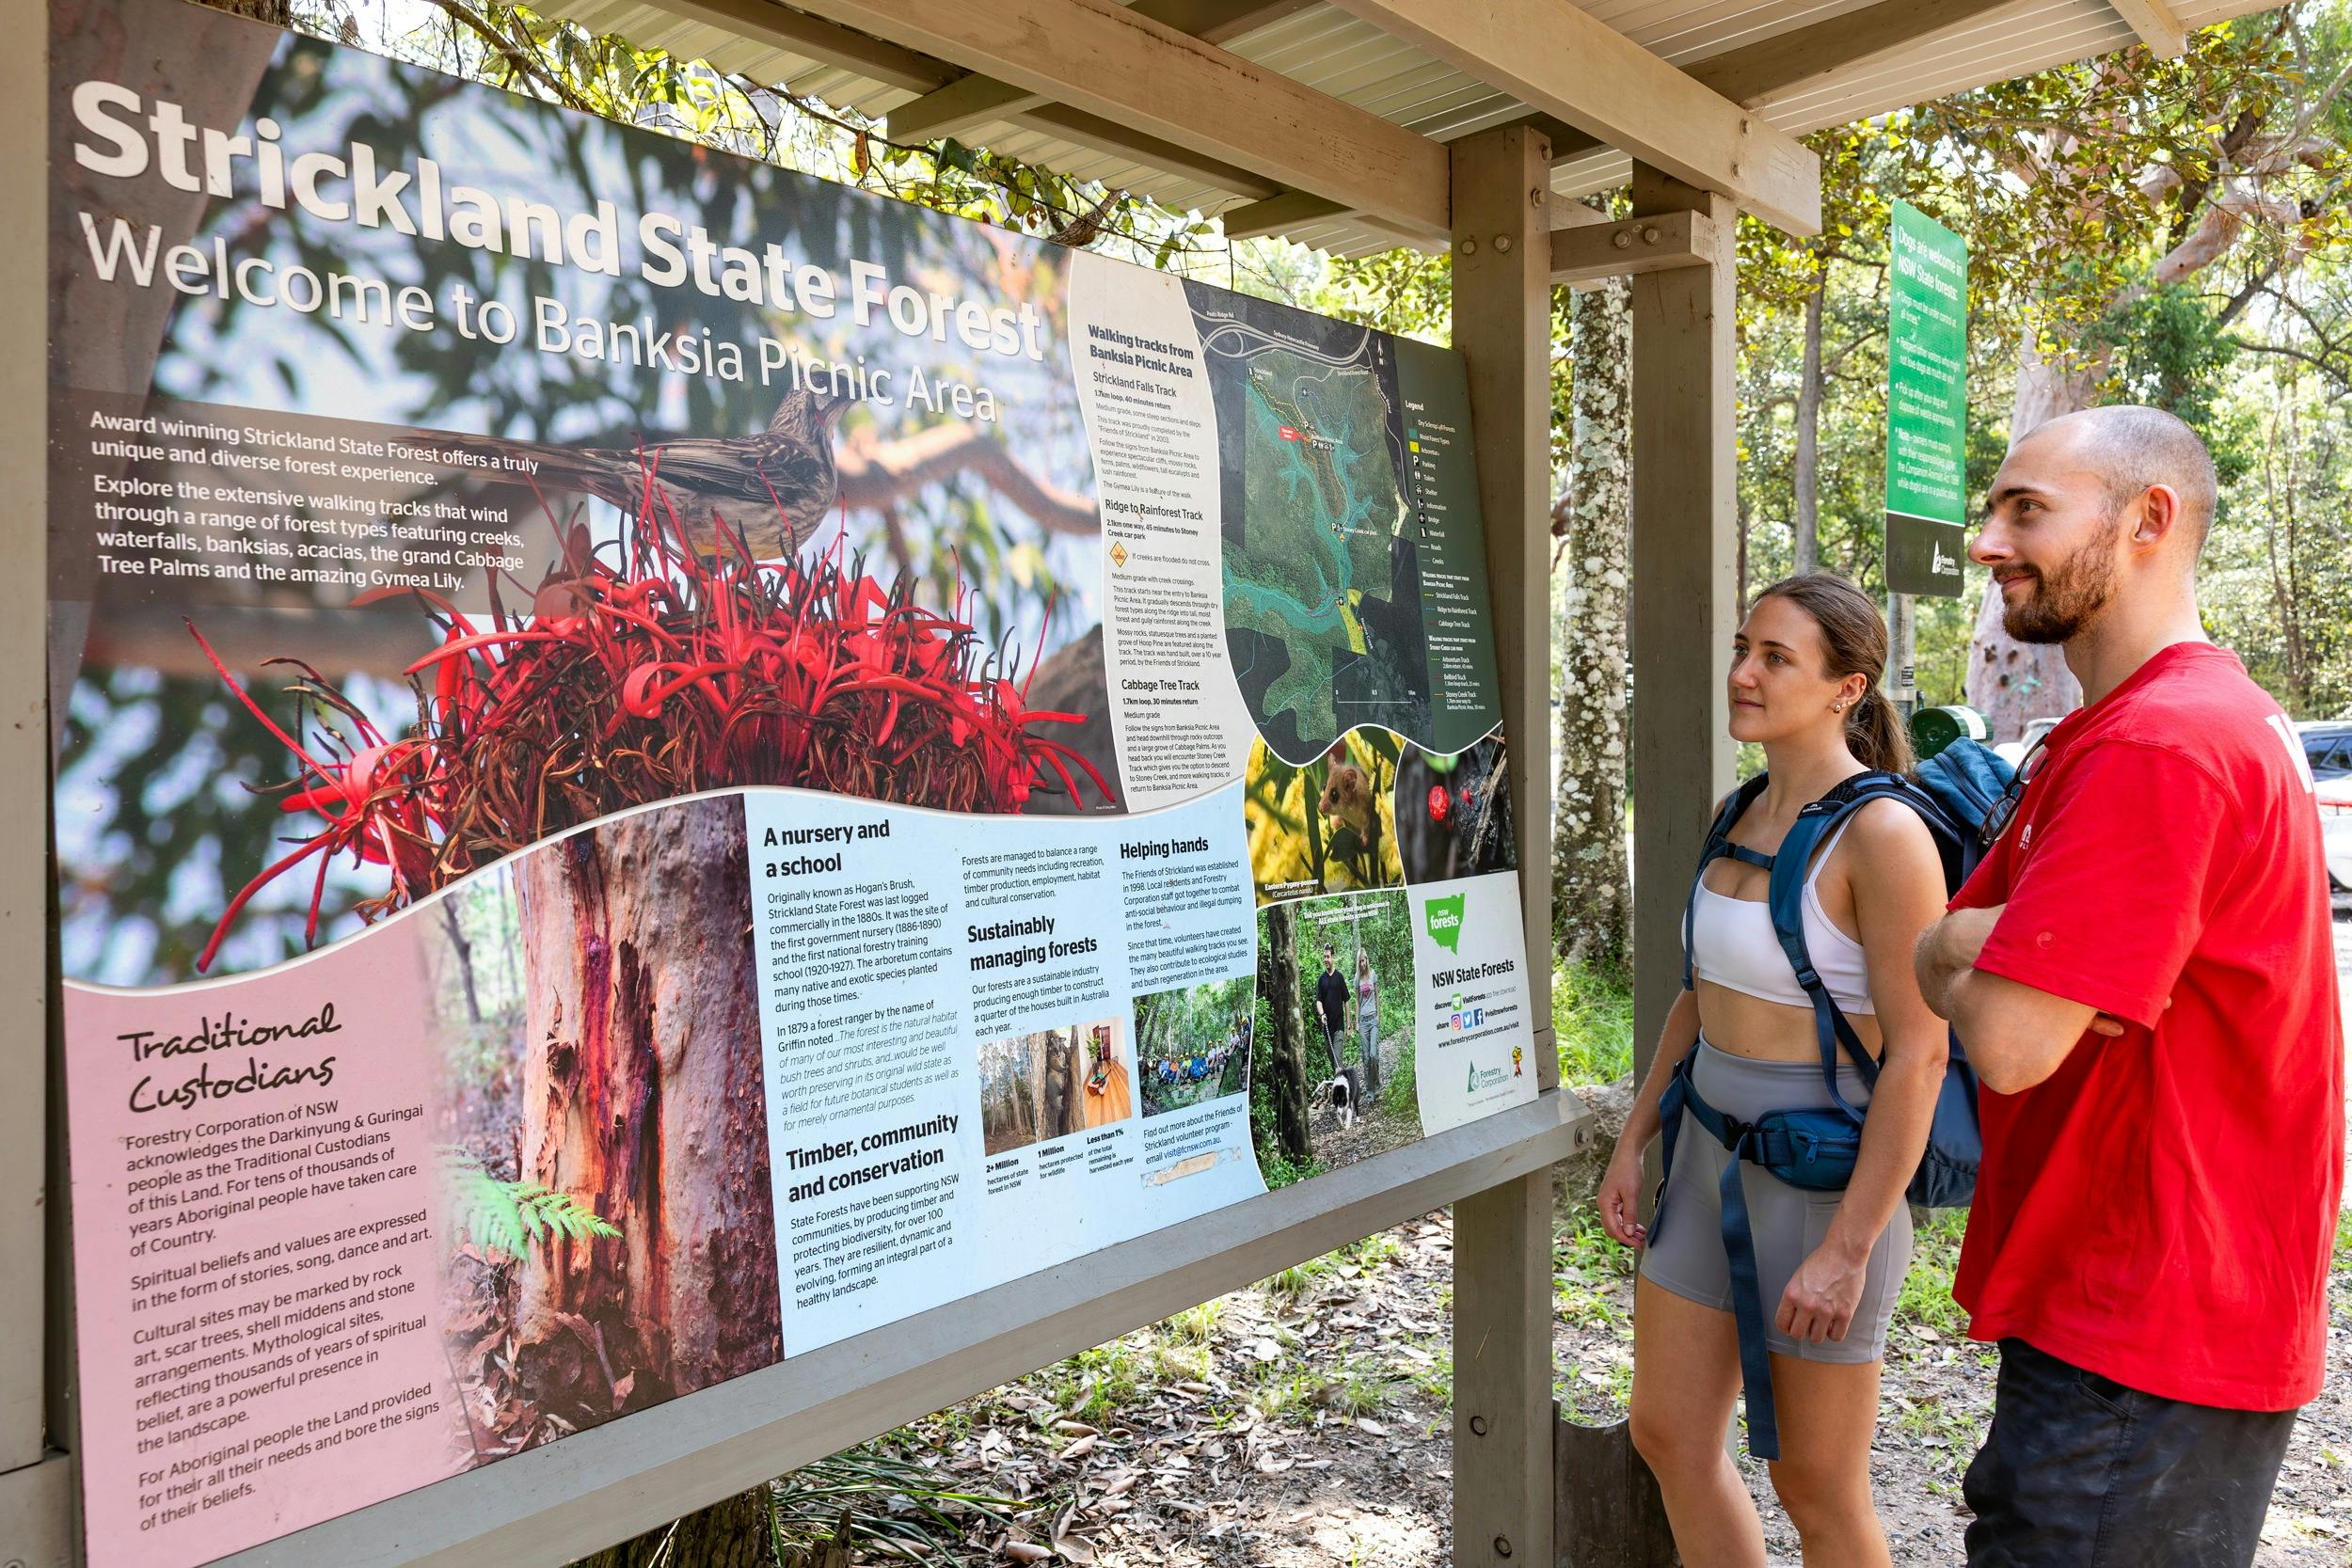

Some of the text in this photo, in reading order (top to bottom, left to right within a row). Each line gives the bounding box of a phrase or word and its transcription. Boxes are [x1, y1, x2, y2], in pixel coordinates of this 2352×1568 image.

[71, 79, 1044, 362] Strickland State Forest
[1899, 226, 1963, 277] Dogs are welcome in
[1899, 254, 1916, 278] NSW
[1917, 264, 1934, 288] State
[77, 211, 999, 422] Welcome to Banksia Picnic Area
[1088, 324, 1194, 359] Walking tracks from
[1089, 343, 1192, 378] Banksia Picnic Area
[1092, 371, 1177, 398] Strickland Falls Track
[1094, 388, 1171, 410] 1.7km loop, 40 minutes return
[1406, 400, 1423, 412] Legend
[89, 410, 538, 475] Award winning Strickland State Forest offers a truly
[91, 439, 437, 485] unique and diverse forest experience.
[94, 474, 508, 523] Explore the extensive walking tracks that wind
[1104, 499, 1203, 520] Ridge to Rainforest Track
[94, 501, 524, 547] through a range of forest types featuring creeks,
[96, 530, 523, 571] waterfalls, banksias, acacias, the grand Cabbage
[97, 555, 464, 592] Tree Palms and the amazing Gymea Lily.
[1120, 678, 1200, 692] Cabbage Tree Track
[763, 818, 890, 847] A nursery and
[1120, 836, 1208, 860] Helping hands
[766, 852, 841, 878] a school
[767, 890, 811, 904] Originally
[812, 888, 842, 898] known
[843, 886, 853, 895] as
[889, 879, 914, 890] Brush,
[967, 915, 1055, 942] Sustainably
[1430, 913, 1458, 929] forests
[970, 937, 1097, 971] managing forests
[1432, 958, 1514, 989] NSW State Forests
[1434, 992, 1486, 1010] discover VisitForests
[1437, 1004, 1518, 1030] share #visitnswforests
[117, 1002, 342, 1062] Traditional
[1438, 1021, 1519, 1049] www.forestrycorporation.com.au/visit
[128, 1055, 338, 1113] Custodians
[1480, 1067, 1502, 1080] Forestry
[1481, 1074, 1508, 1088] Corporation
[125, 1100, 338, 1150] Forestry Corporation of NSW
[126, 1106, 422, 1171] acknowledges the Darkinyung & Guringai
[1086, 1127, 1123, 1145] Less than 1%
[786, 1115, 958, 1170] Timber, community
[1037, 1146, 1064, 1158] 1 Million
[788, 1148, 944, 1202] and conservation
[985, 1158, 1019, 1173] 2+ Million
[790, 1173, 959, 1229] State Forests have been supporting NSW
[796, 1275, 878, 1309] healthy landscape.
